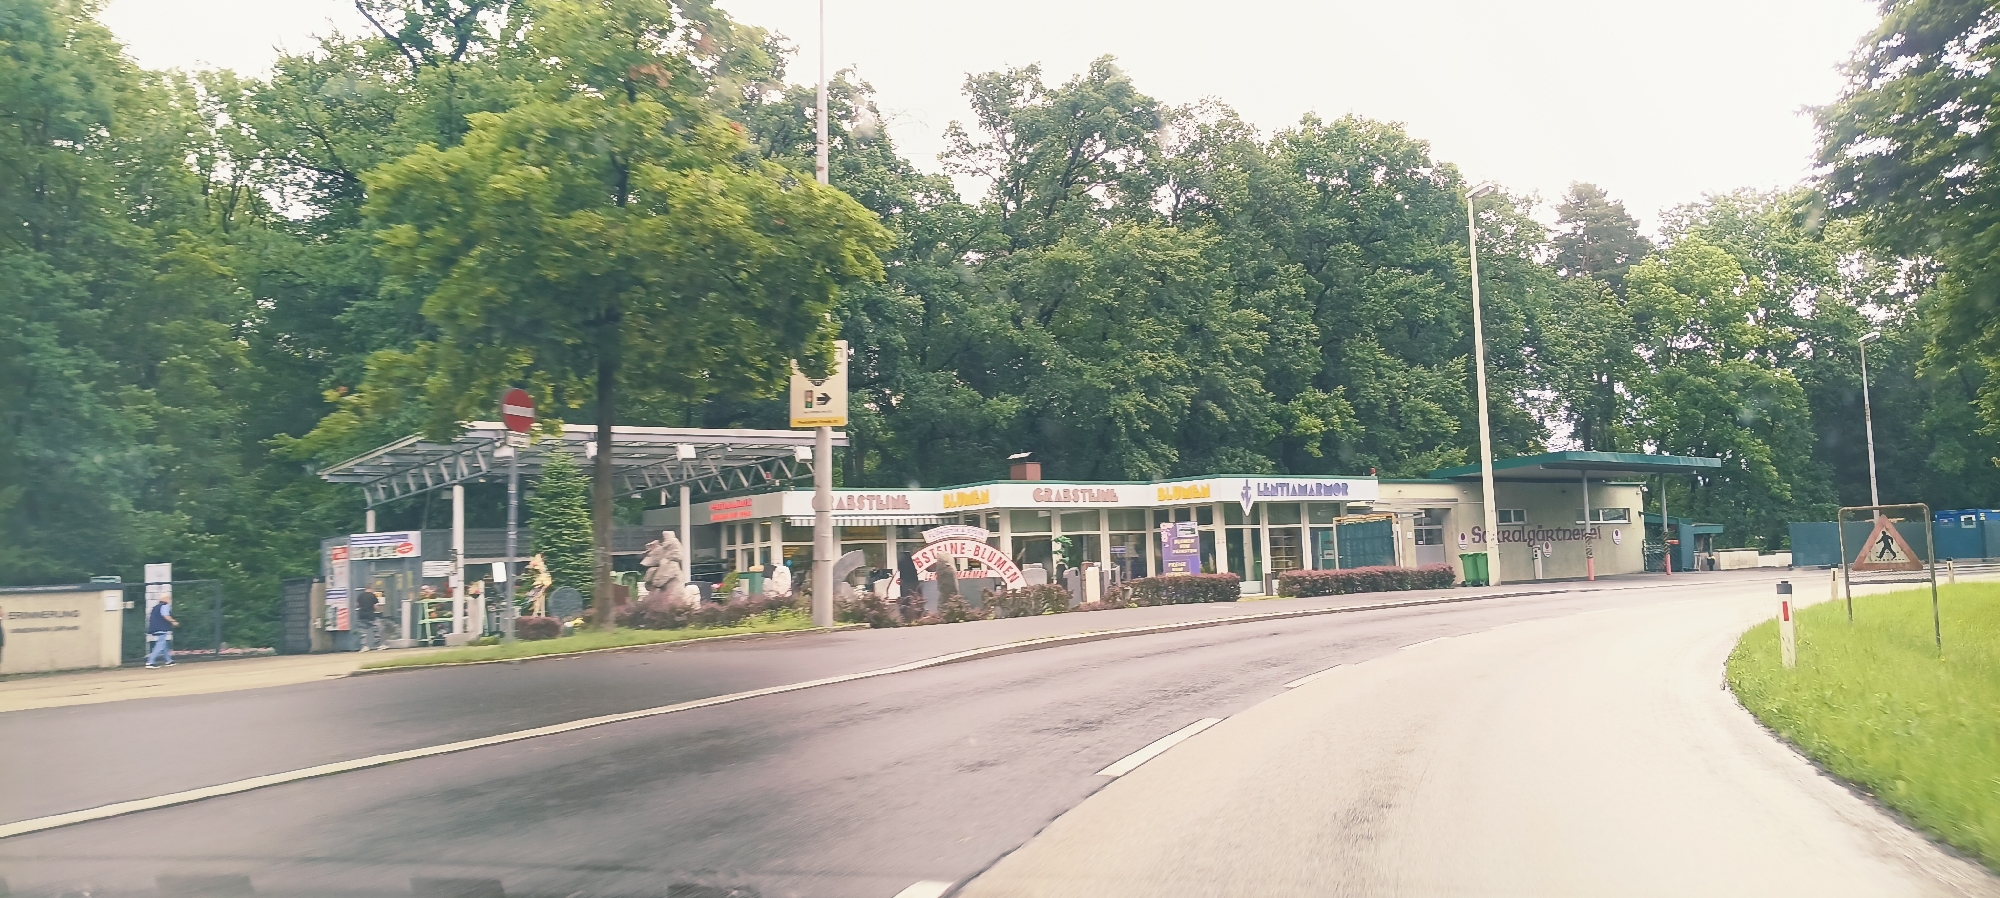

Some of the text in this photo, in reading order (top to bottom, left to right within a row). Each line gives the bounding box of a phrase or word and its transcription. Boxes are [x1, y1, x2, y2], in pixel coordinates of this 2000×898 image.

[1032, 487, 1119, 503] GRABSTEINE
[1157, 483, 1211, 502] BLUMEN
[1257, 482, 1349, 497] LENTIAMARMOR
[943, 489, 990, 509] BLUMEN
